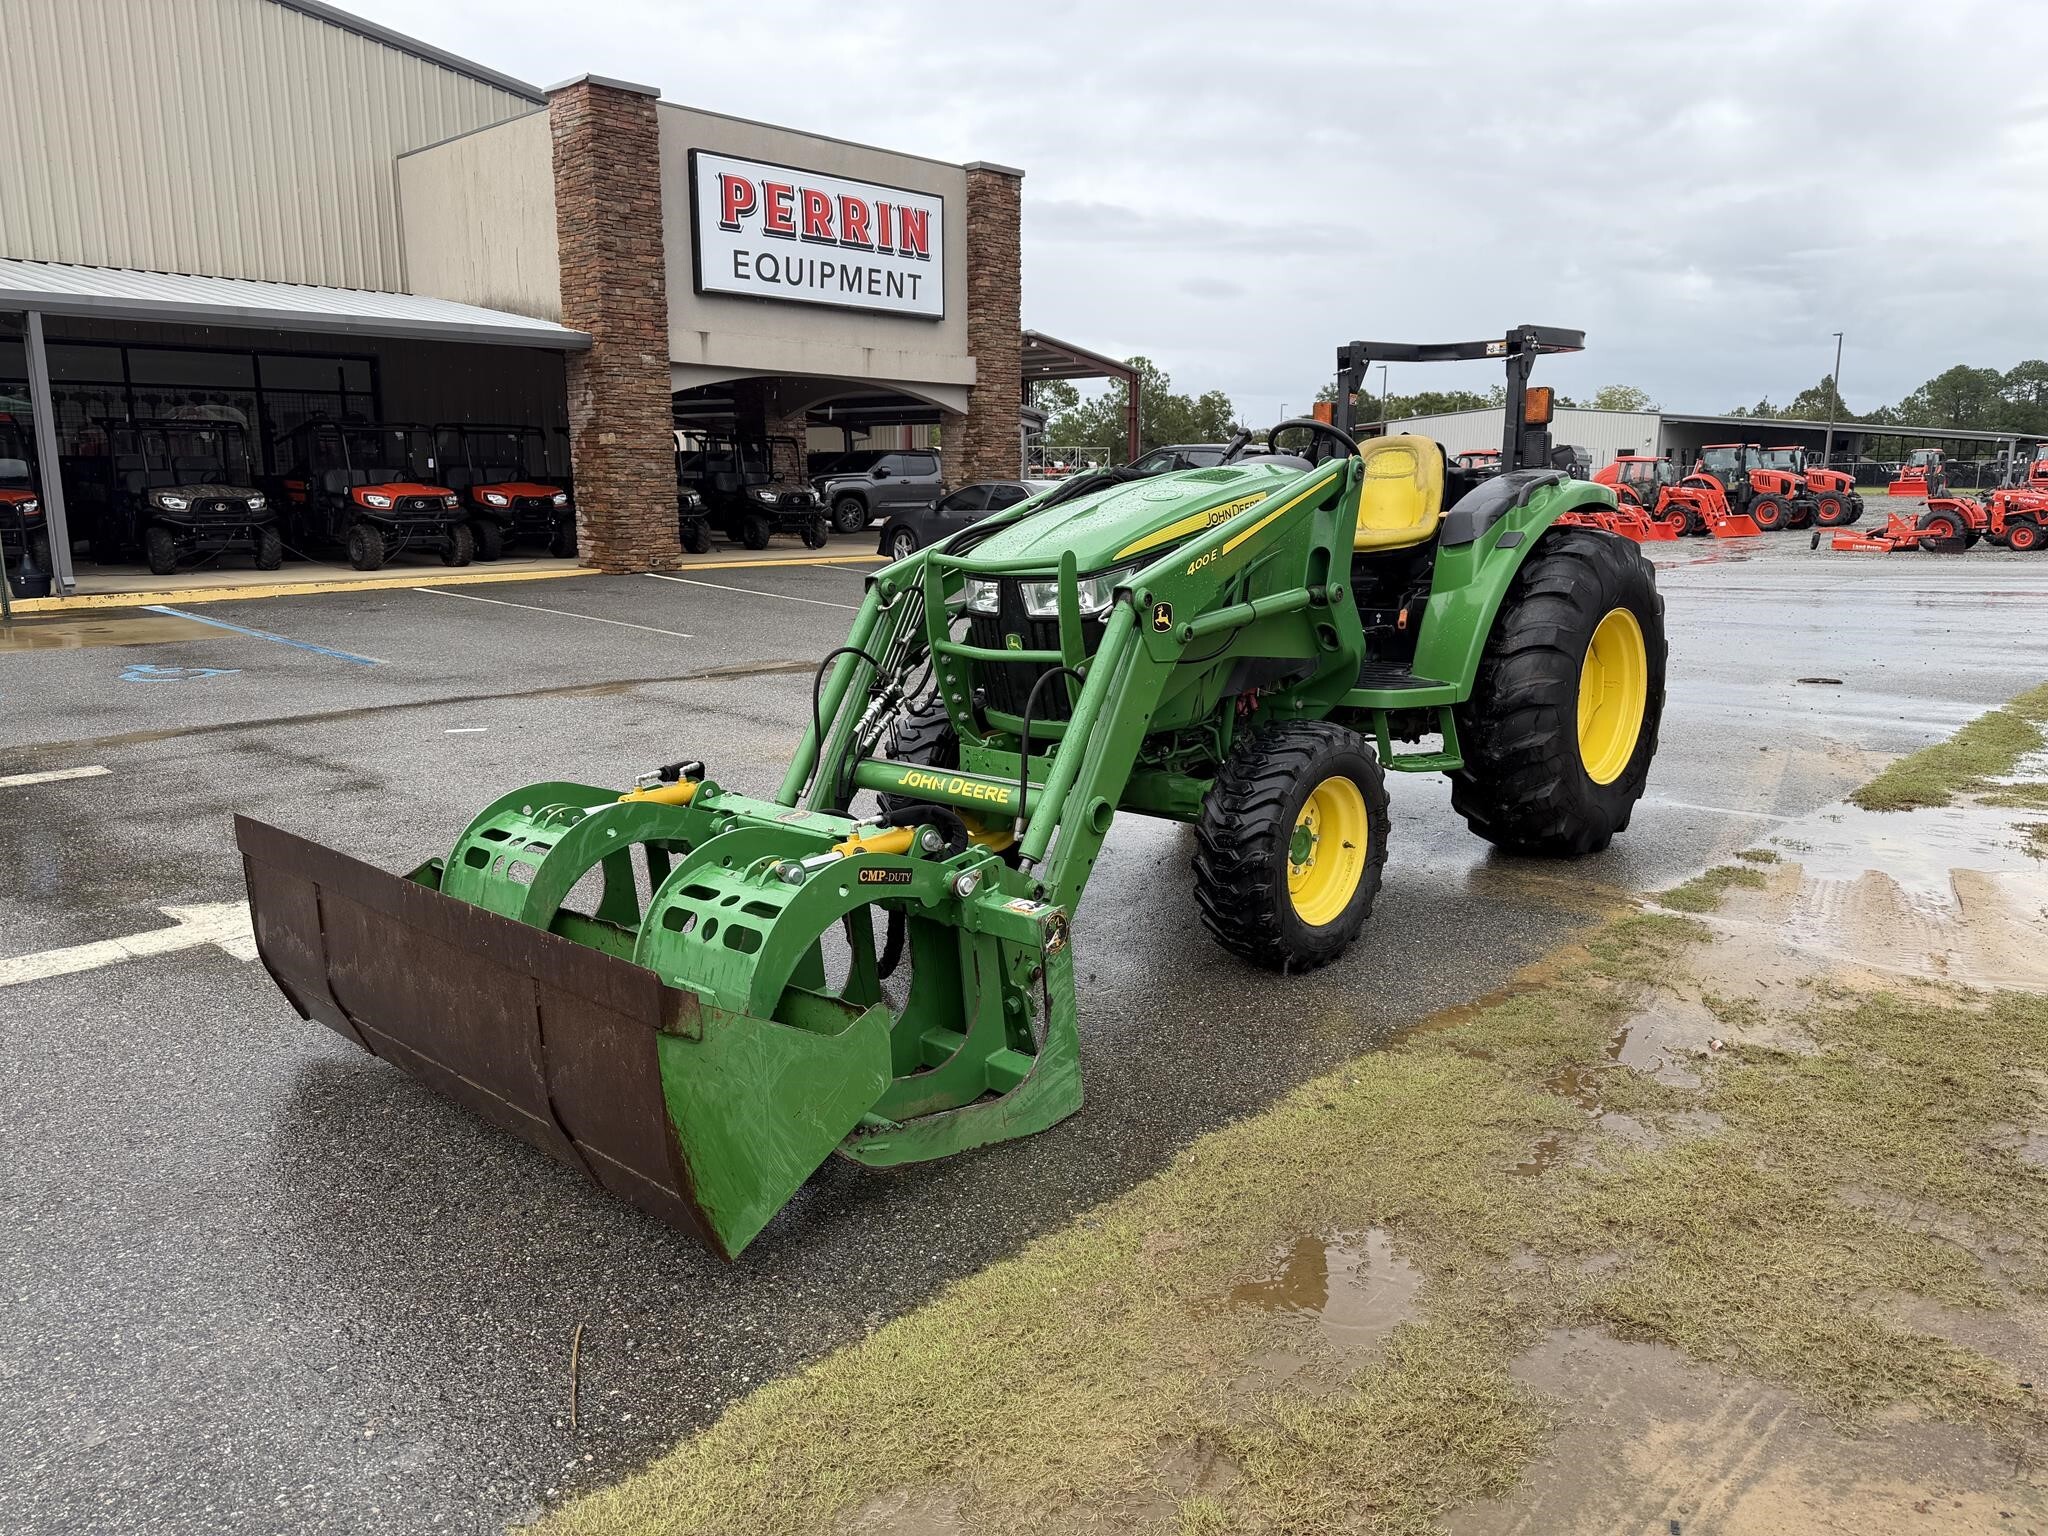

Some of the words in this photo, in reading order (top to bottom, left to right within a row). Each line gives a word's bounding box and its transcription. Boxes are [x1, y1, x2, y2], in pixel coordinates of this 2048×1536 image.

[716, 171, 932, 262] PERRIN
[733, 249, 922, 300] EQUIPMENT
[1206, 508, 1232, 527] JOHN
[898, 769, 947, 792] JOHN
[947, 777, 1012, 804] DEERE
[859, 870, 912, 882] CMP-DUTY
